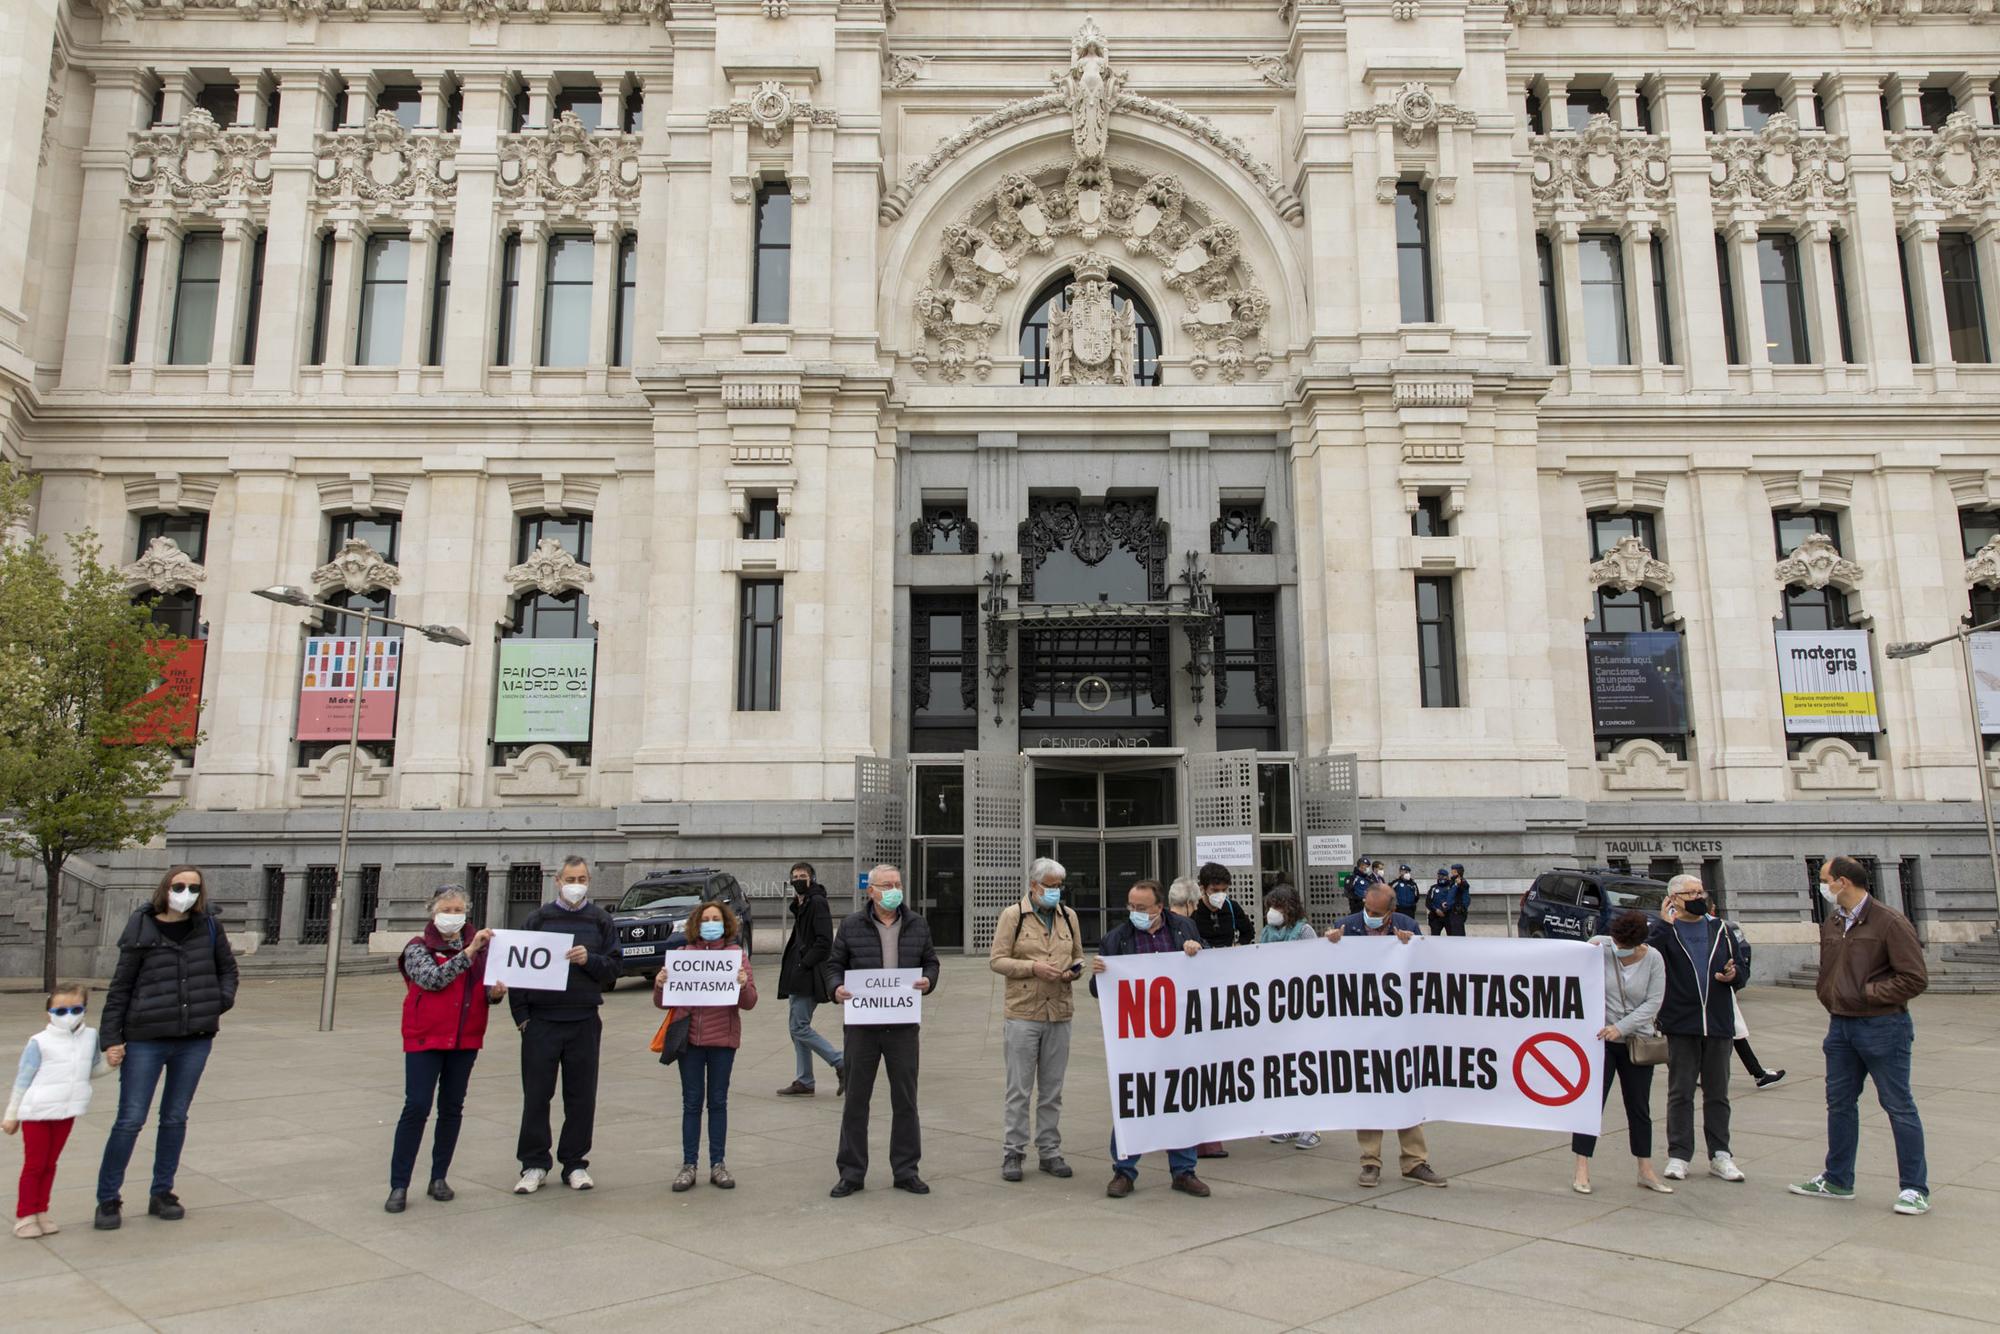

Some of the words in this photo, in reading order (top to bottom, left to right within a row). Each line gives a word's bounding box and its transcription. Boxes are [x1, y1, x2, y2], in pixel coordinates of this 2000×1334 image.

[1791, 645, 1856, 660] materia
[1594, 656, 1632, 664] Estamos
[503, 667, 587, 678] PANORAMA
[1595, 668, 1640, 676] Canciones
[1826, 660, 1857, 675] gris
[502, 681, 559, 691] MADRID
[566, 681, 587, 691] 01
[1618, 676, 1647, 686] pasado
[1596, 684, 1636, 692] olvidado
[1605, 842, 1663, 853] TAQUILLA
[1672, 841, 1722, 852] TICKETS
[507, 945, 551, 970] NO
[672, 960, 733, 972] COCINAS
[669, 980, 736, 992] FANTASMA
[865, 978, 900, 988] CALLE
[852, 996, 914, 1008] CANILLAS
[1118, 976, 1177, 1039] NO
[1184, 989, 1202, 1034] A
[1210, 982, 1260, 1031] LAS
[1268, 972, 1404, 1023] COCINAS
[1410, 972, 1585, 1020] FANTASMA
[1118, 1072, 1156, 1118] EN
[1163, 1058, 1255, 1113] ZONAS
[1263, 1045, 1498, 1099] RESIDENCIALES
